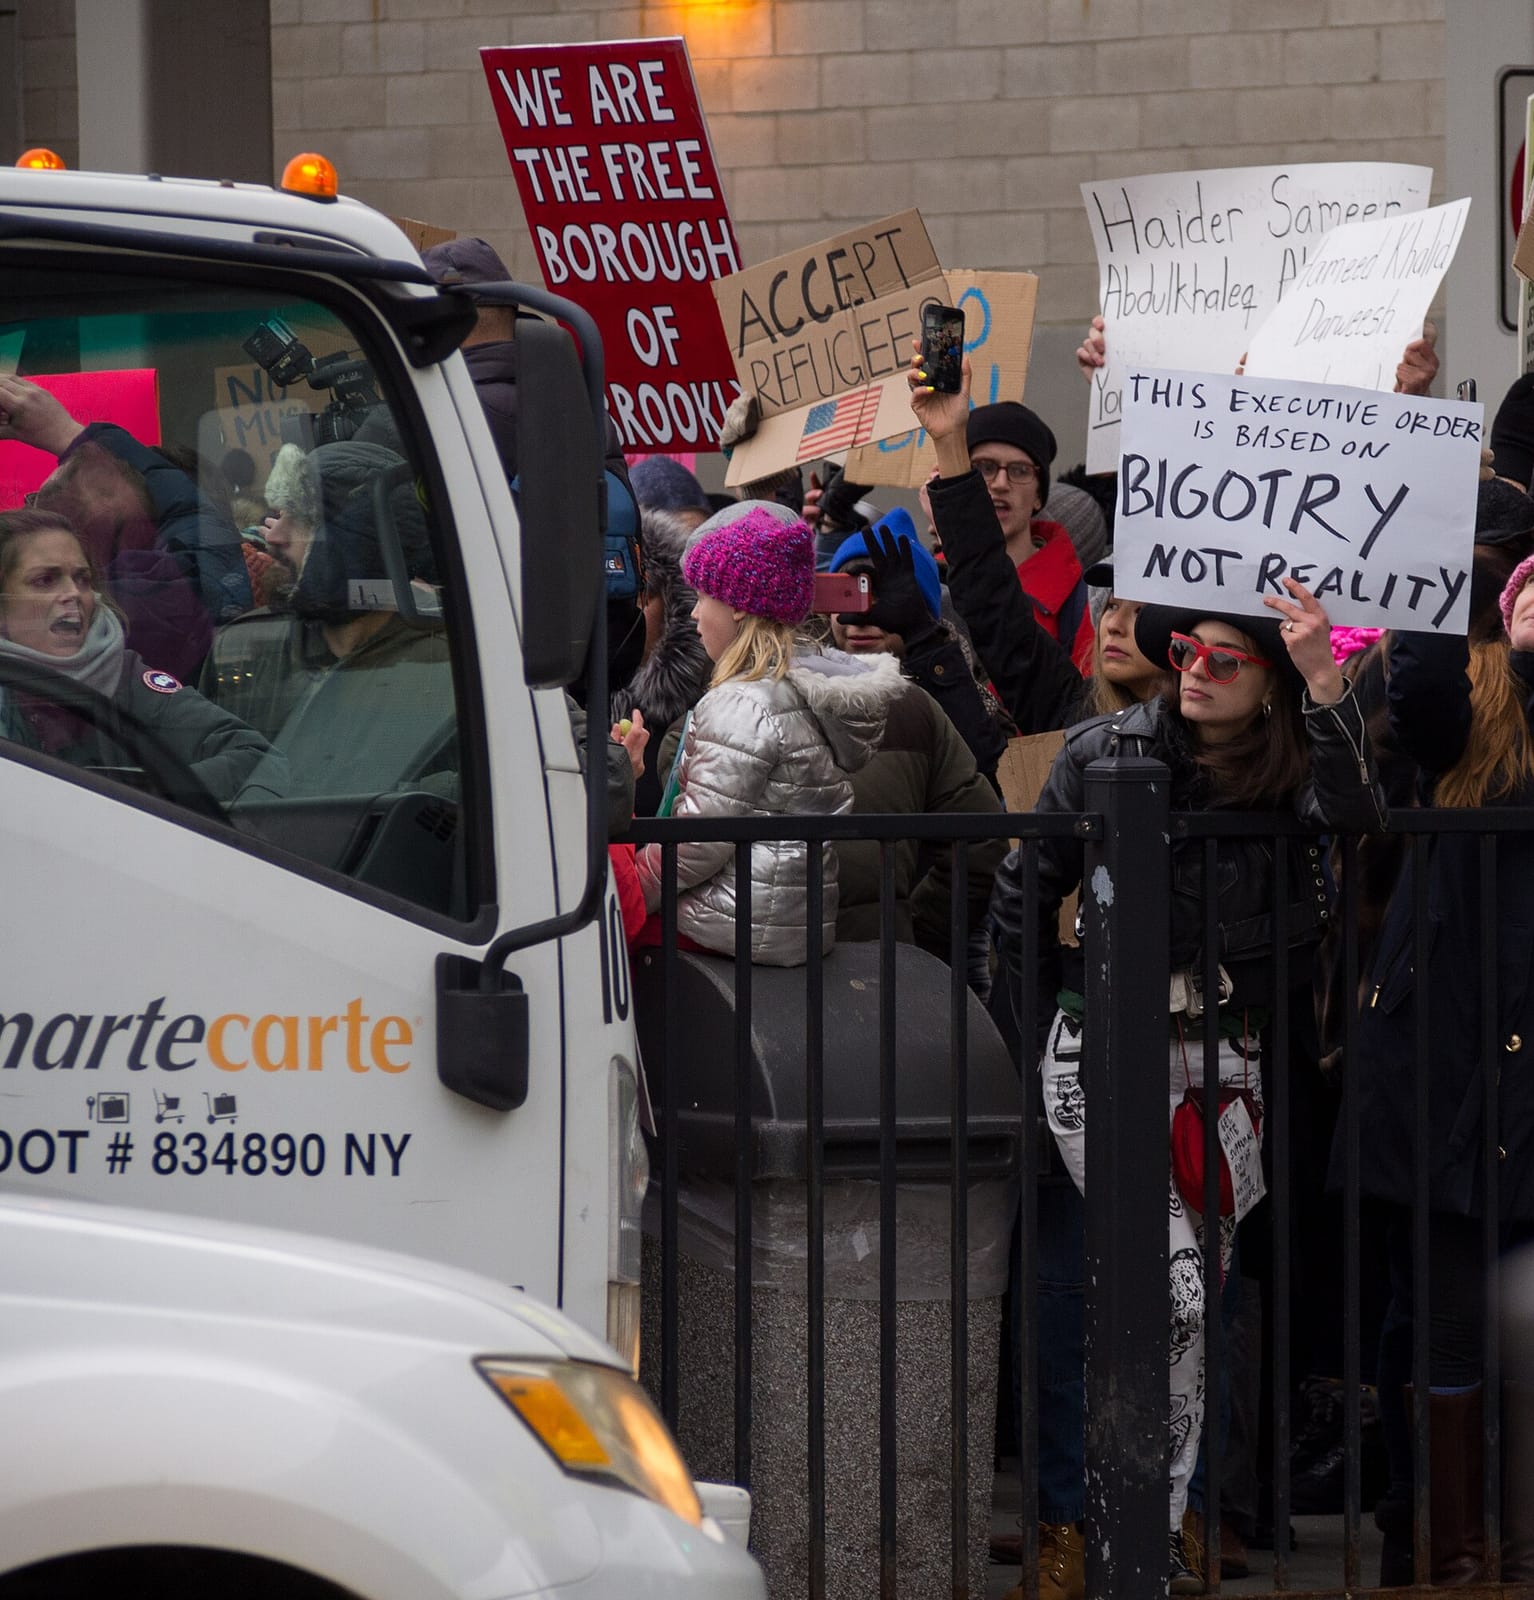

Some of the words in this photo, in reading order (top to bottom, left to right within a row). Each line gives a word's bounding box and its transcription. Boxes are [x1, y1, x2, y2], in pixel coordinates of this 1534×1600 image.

[496, 67, 573, 127] WE
[588, 60, 675, 125] ARE
[513, 145, 600, 202] THE
[601, 139, 715, 200] FREE
[536, 217, 740, 284] BOROUGH
[1093, 180, 1244, 255] Haider
[1383, 208, 1463, 280] Khalid
[738, 228, 910, 358] ACCEPT
[1103, 256, 1257, 330] Abdulkhaleq
[626, 305, 680, 367] OF
[1130, 373, 1207, 409] THIS
[1229, 389, 1379, 426] EXECUTIVE
[1395, 410, 1482, 442] ORDER
[1194, 420, 1214, 440] IS
[1235, 424, 1331, 453] BASED
[1341, 441, 1391, 459] ON
[1121, 453, 1410, 560] BIGOTRY
[1142, 543, 1243, 587] NOT
[1255, 552, 1468, 629] REALITY
[106, 1132, 134, 1174] #
[152, 1131, 326, 1176] 834890
[344, 1132, 412, 1176] NY
